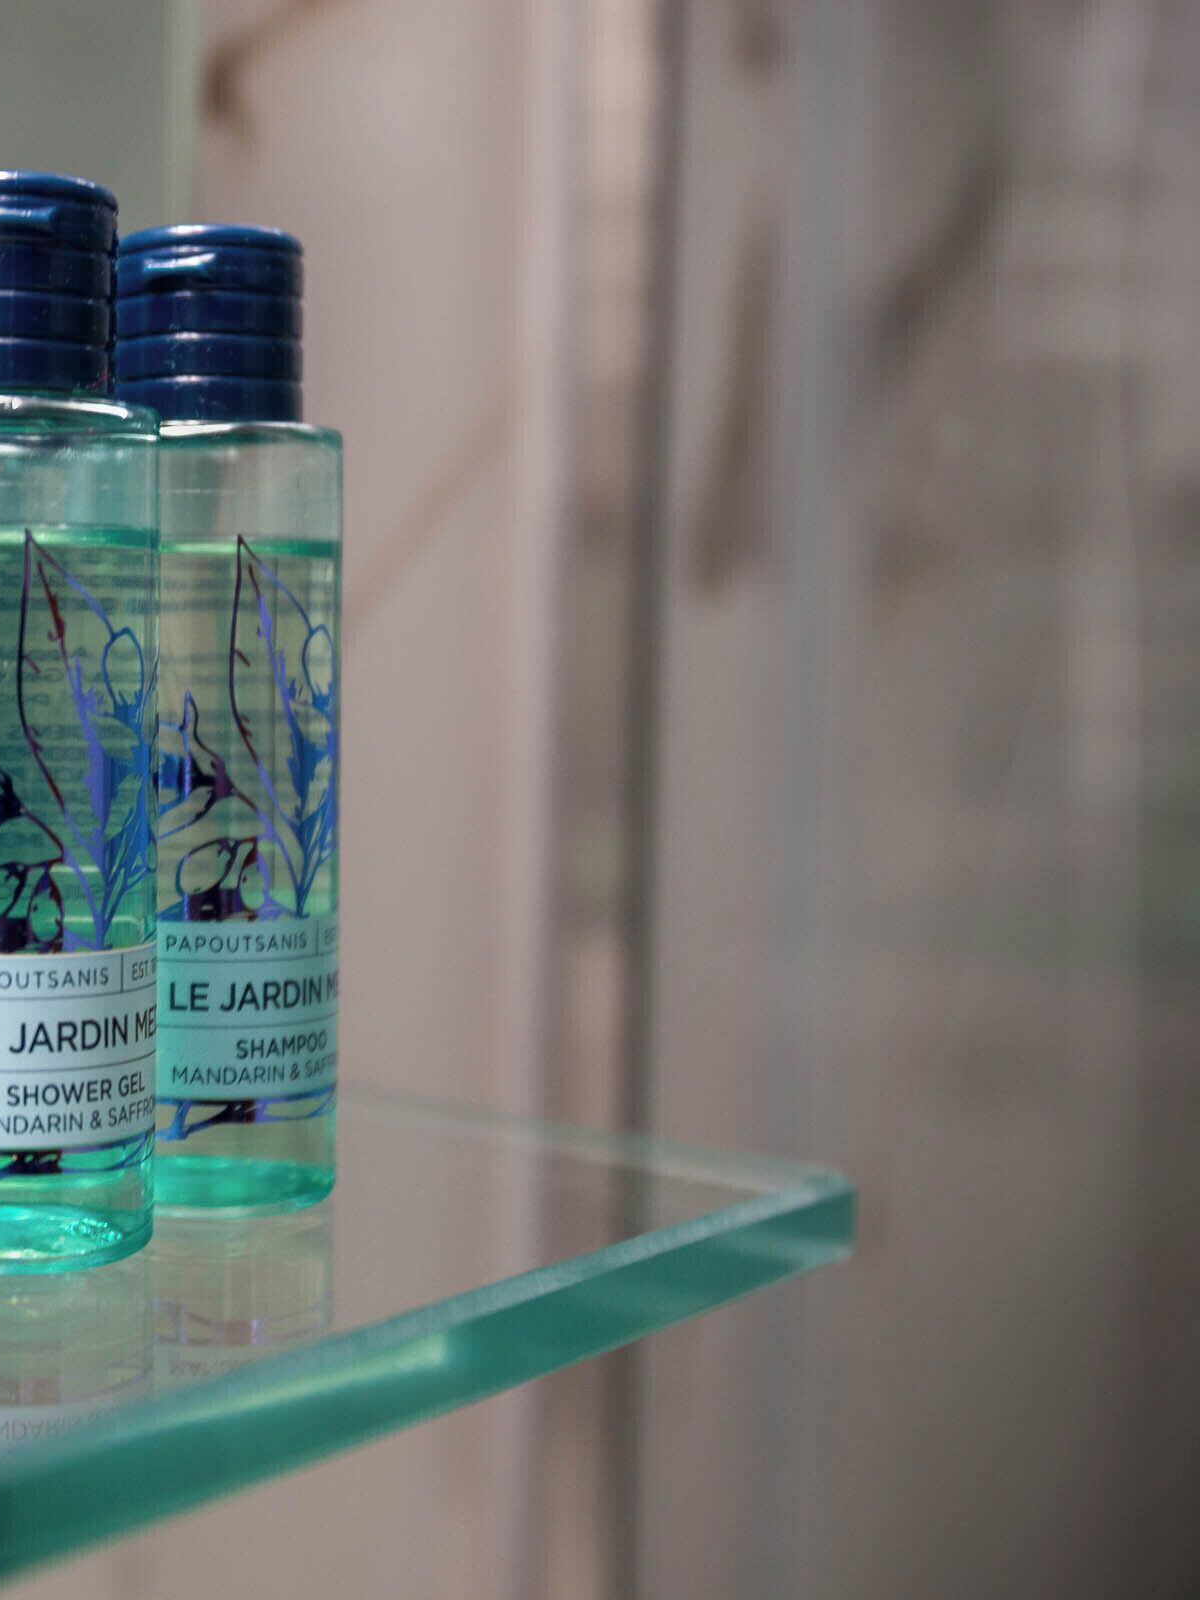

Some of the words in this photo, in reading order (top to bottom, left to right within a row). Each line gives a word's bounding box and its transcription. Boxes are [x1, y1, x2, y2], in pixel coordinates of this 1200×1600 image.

[166, 933, 307, 953] PAPOUTSANIS
[132, 961, 148, 981] EST
[169, 981, 210, 1012] LE
[220, 973, 321, 1012] JARDIN
[9, 1015, 129, 1054] JARDIN
[236, 1030, 328, 1060] SHAMPOO
[172, 1064, 285, 1085] MANDARIN
[290, 1062, 300, 1080] &
[7, 1079, 112, 1107] SHOWER
[118, 1072, 145, 1097] GEL
[90, 1109, 102, 1129] &
